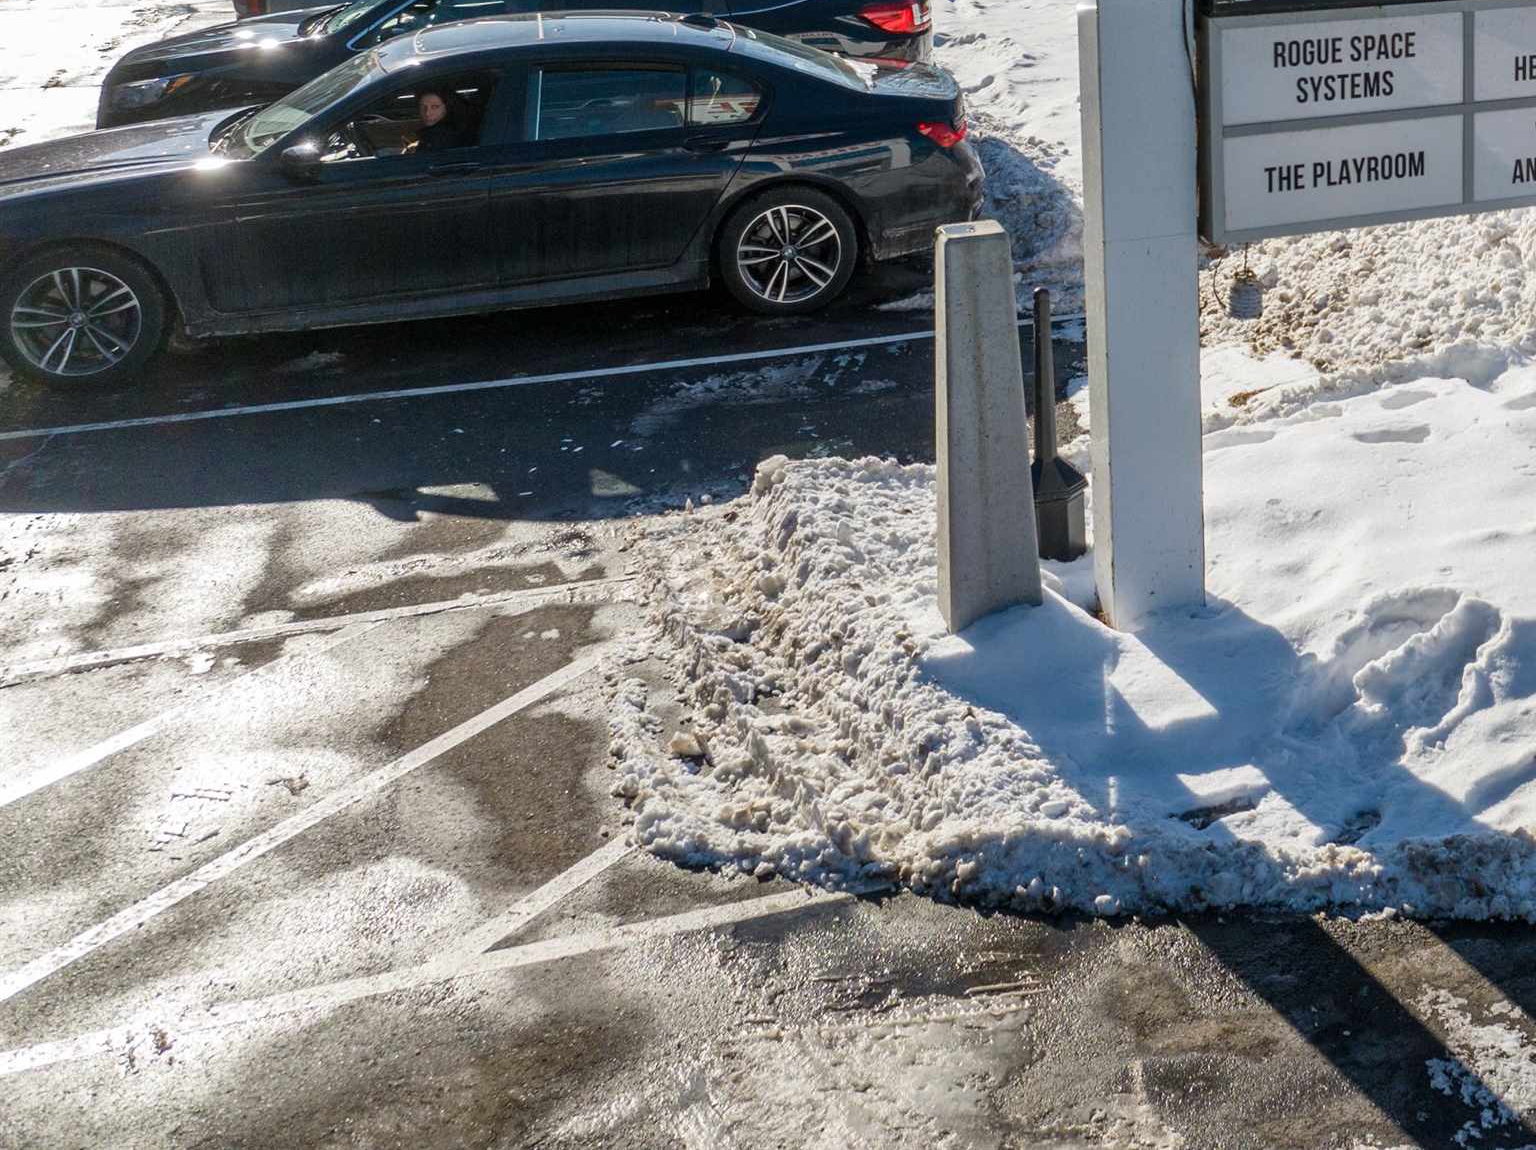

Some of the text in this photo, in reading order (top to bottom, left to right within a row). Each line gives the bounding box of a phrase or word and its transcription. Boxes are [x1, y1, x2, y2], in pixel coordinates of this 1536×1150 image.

[1273, 32, 1416, 68] ROGUE SPACE
[1296, 71, 1394, 103] SYSTEMS
[1264, 151, 1426, 193] THE PLAYROOM
